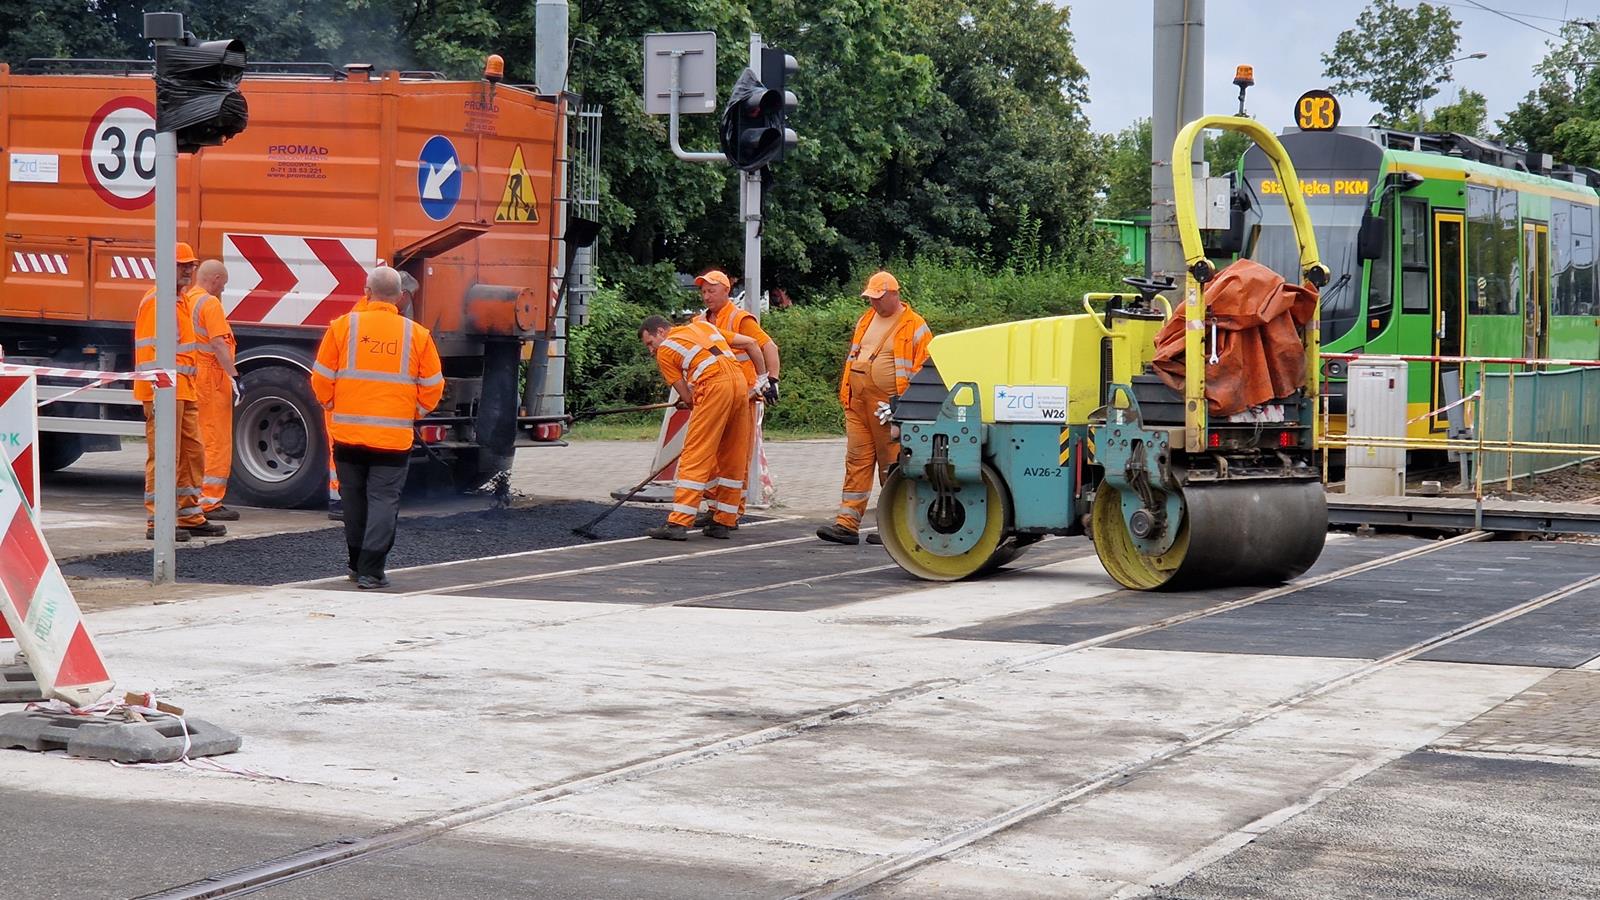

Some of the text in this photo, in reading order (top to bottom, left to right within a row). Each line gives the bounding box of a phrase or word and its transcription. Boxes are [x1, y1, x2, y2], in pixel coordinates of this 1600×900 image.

[1300, 98, 1334, 128] 93
[98, 127, 156, 180] 30
[268, 145, 329, 156] PROMAD
[1261, 180, 1368, 197] Stałęka PKM
[1042, 409, 1065, 419] W26
[1023, 467, 1062, 477] AV26-2
